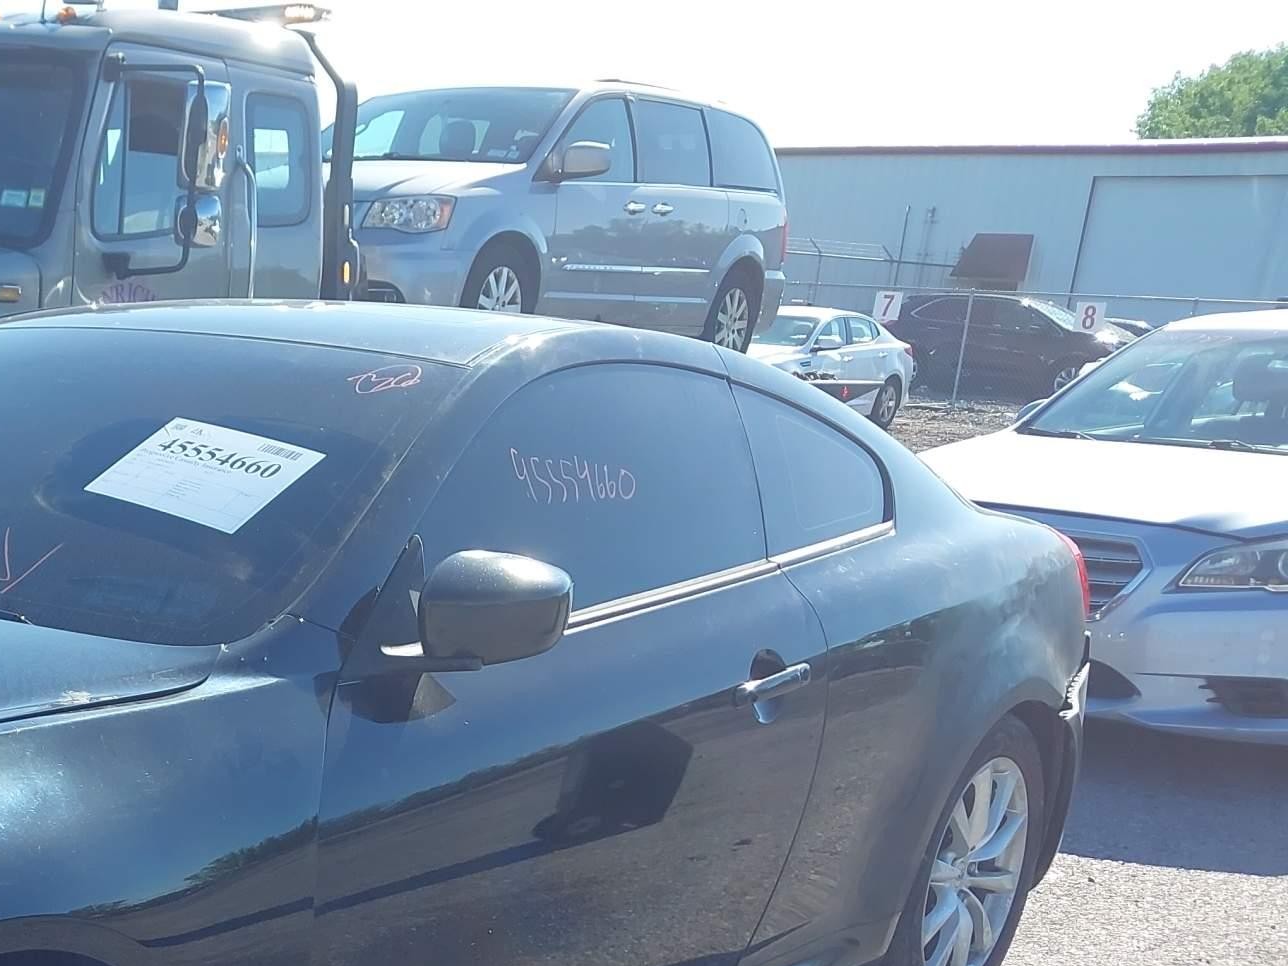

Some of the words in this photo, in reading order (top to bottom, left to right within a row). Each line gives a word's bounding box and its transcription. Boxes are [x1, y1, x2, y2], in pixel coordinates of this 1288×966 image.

[883, 294, 895, 317] 7
[1081, 304, 1097, 330] 8
[159, 438, 282, 479] 45554660
